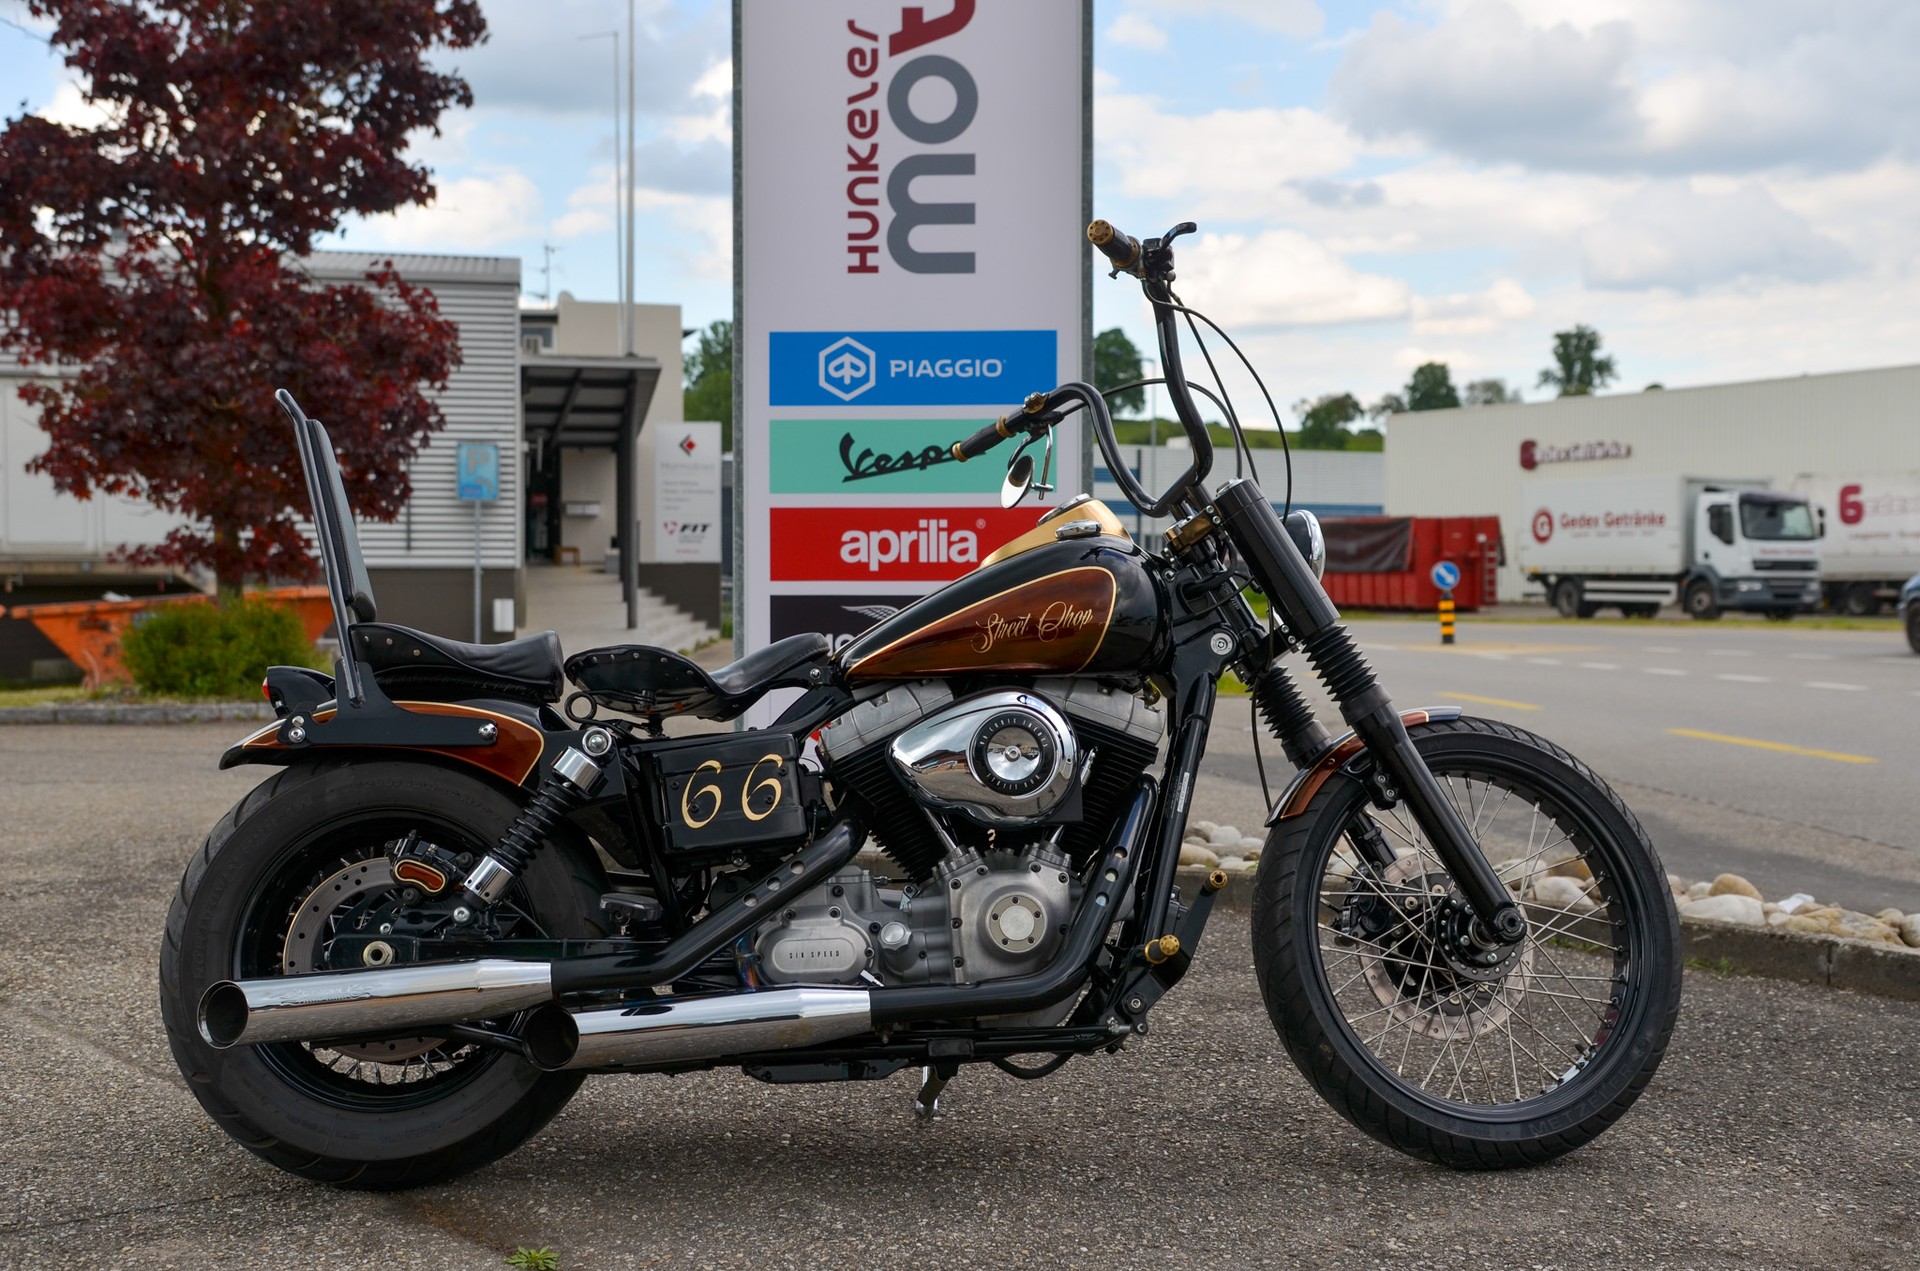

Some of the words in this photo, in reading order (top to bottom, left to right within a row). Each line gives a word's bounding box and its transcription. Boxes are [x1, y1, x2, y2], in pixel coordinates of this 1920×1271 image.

[889, 358, 1003, 378] PIAGGIO
[468, 449, 489, 474] P
[838, 432, 987, 483] Vesp
[680, 523, 711, 533] FIT
[840, 519, 978, 572] aprilia
[810, 950, 840, 959] SPEED
